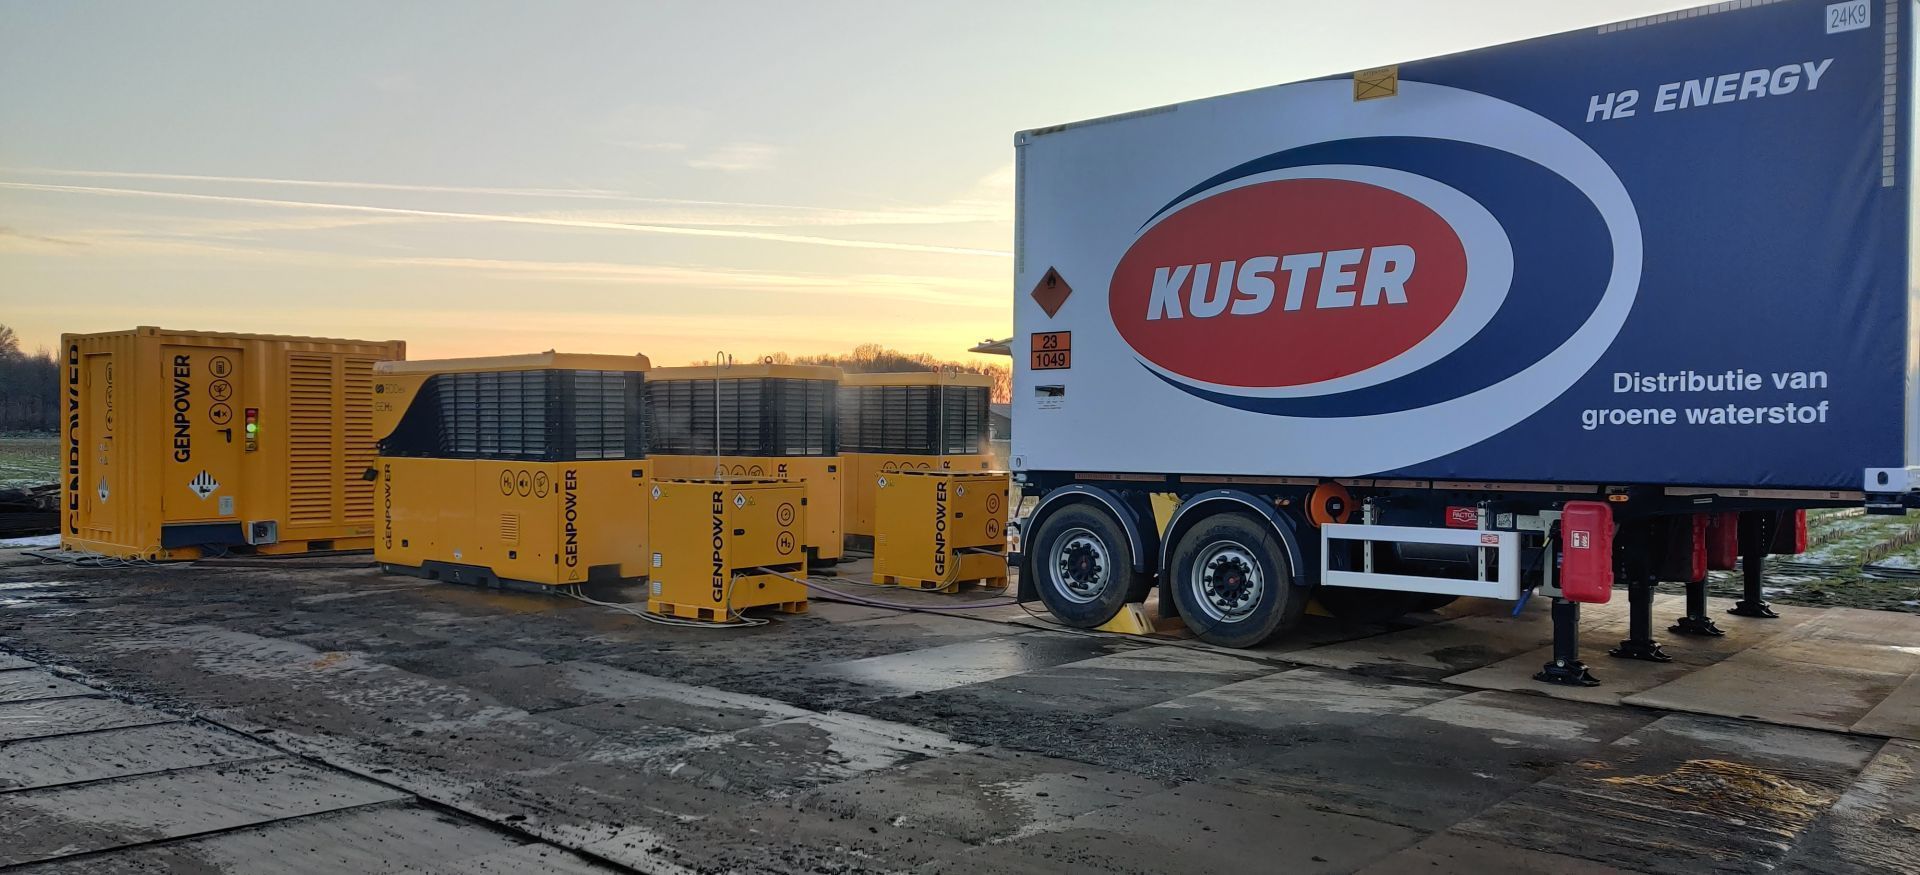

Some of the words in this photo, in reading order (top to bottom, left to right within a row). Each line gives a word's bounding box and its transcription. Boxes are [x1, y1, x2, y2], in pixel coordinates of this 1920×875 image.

[1831, 5, 1867, 29] 24K9
[1586, 89, 1639, 122] H2
[1654, 58, 1834, 112] ENERGY
[1146, 244, 1416, 321] KUSTER
[1036, 352, 1066, 367] 1049
[1042, 335, 1058, 349] 23
[174, 354, 191, 463] GENPOWER
[1613, 369, 1762, 393] Distributie
[1772, 370, 1828, 390] van
[1581, 408, 1677, 430] groene
[1685, 400, 1829, 425] waterstof
[565, 469, 578, 568] GENPOWER
[712, 490, 723, 602] GENPOWER
[935, 481, 948, 576] GENPOWER
